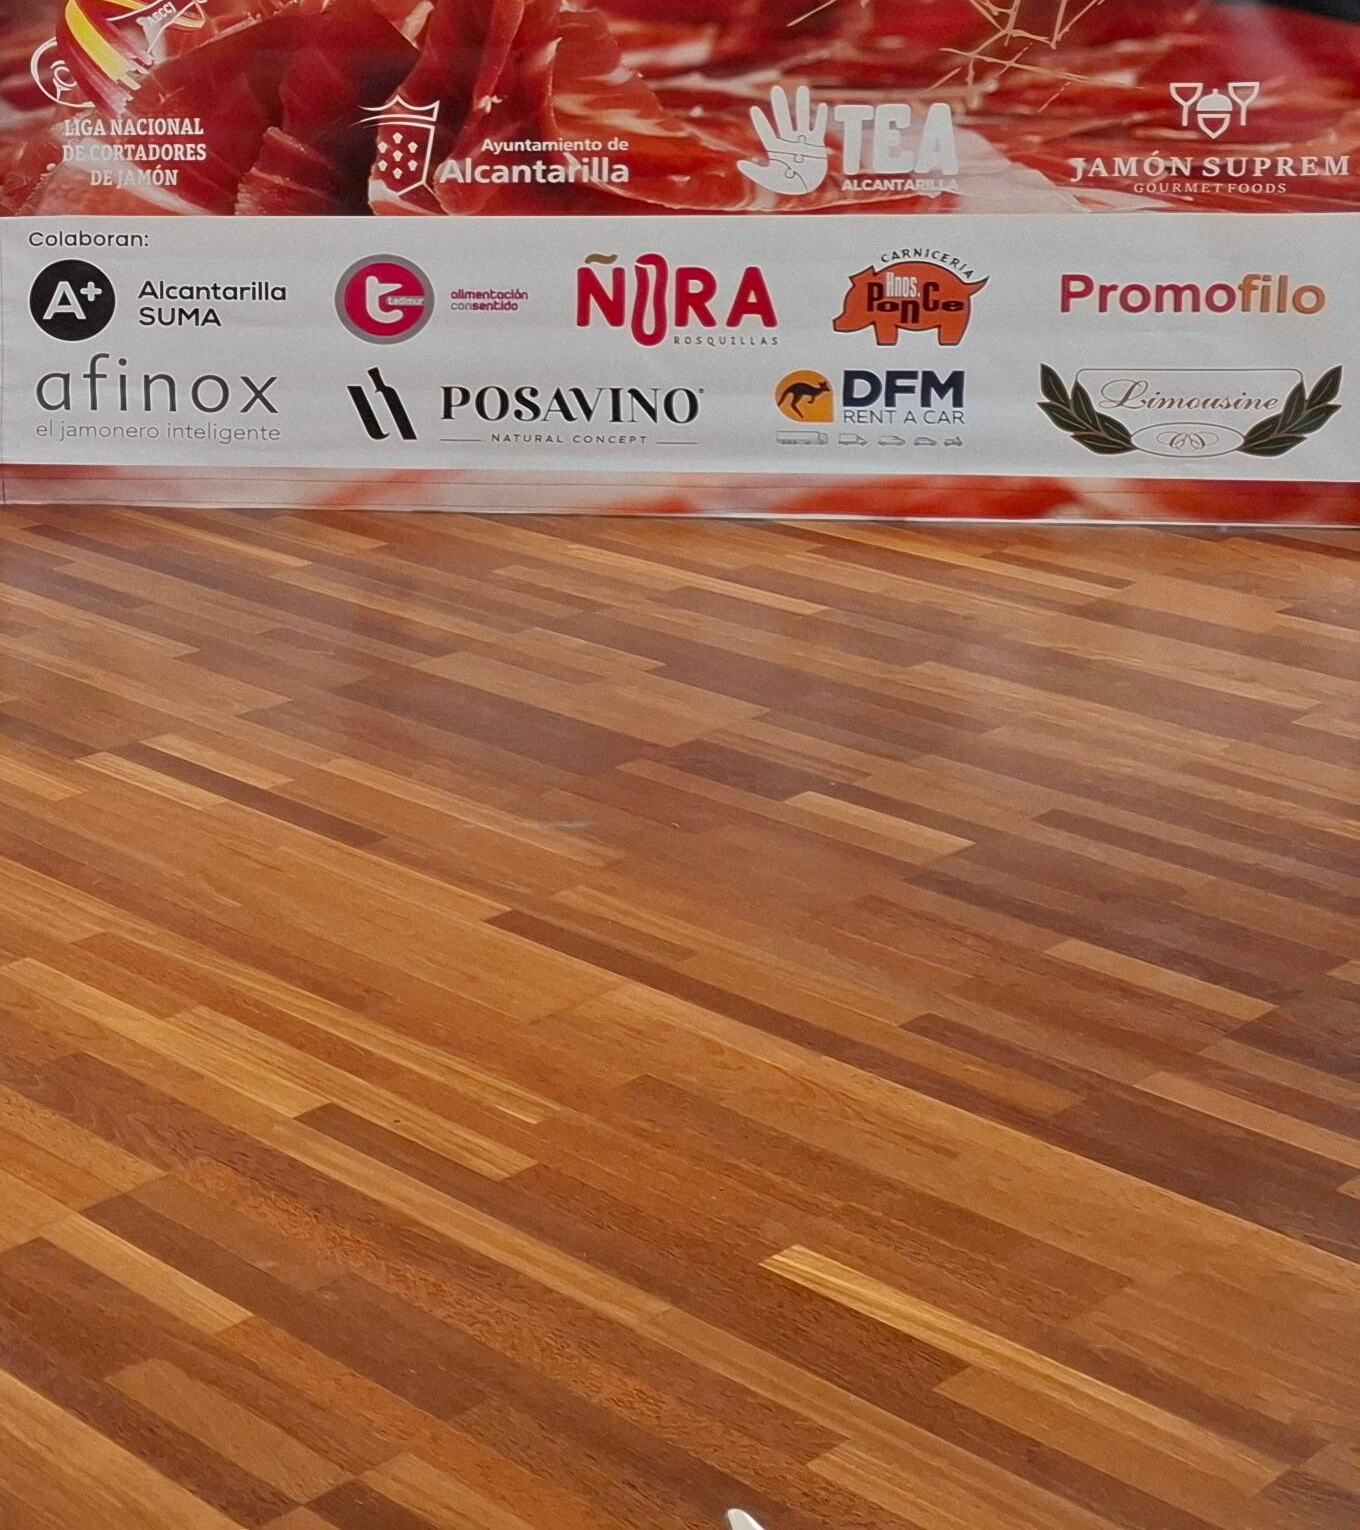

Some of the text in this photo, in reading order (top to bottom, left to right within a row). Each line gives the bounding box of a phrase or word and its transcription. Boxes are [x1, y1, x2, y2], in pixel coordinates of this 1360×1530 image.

[64, 118, 203, 136] LIGA NACIONAL
[481, 137, 629, 155] Ayuntamiento de
[834, 102, 959, 175] TEA
[63, 143, 206, 161] DE CORTADORES
[90, 164, 178, 188] DE JAMÓN
[439, 157, 629, 183] Alcantarilla
[1067, 150, 1351, 182] JAMÓN SUPREM
[841, 179, 959, 192] ALCANTARILLA
[1134, 182, 1287, 194] GOURMET FOODS
[28, 230, 149, 247] Colaboran:
[42, 280, 102, 320] A+
[138, 280, 287, 301] Alcantarilla
[451, 288, 529, 299] alimentación
[576, 253, 778, 346] ÑORA
[1060, 273, 1326, 315] Promofilo
[451, 301, 519, 311] consentido
[139, 307, 222, 327] SUMA
[674, 335, 778, 346] ROSQUILLAS
[36, 353, 278, 413] afinox
[843, 370, 965, 408] DFM
[1098, 379, 1279, 410] Limousine
[844, 410, 965, 424] RENT A CAR
[36, 420, 280, 444] el jamonero inteligente
[491, 433, 648, 445] NATURAL CONCEPT
